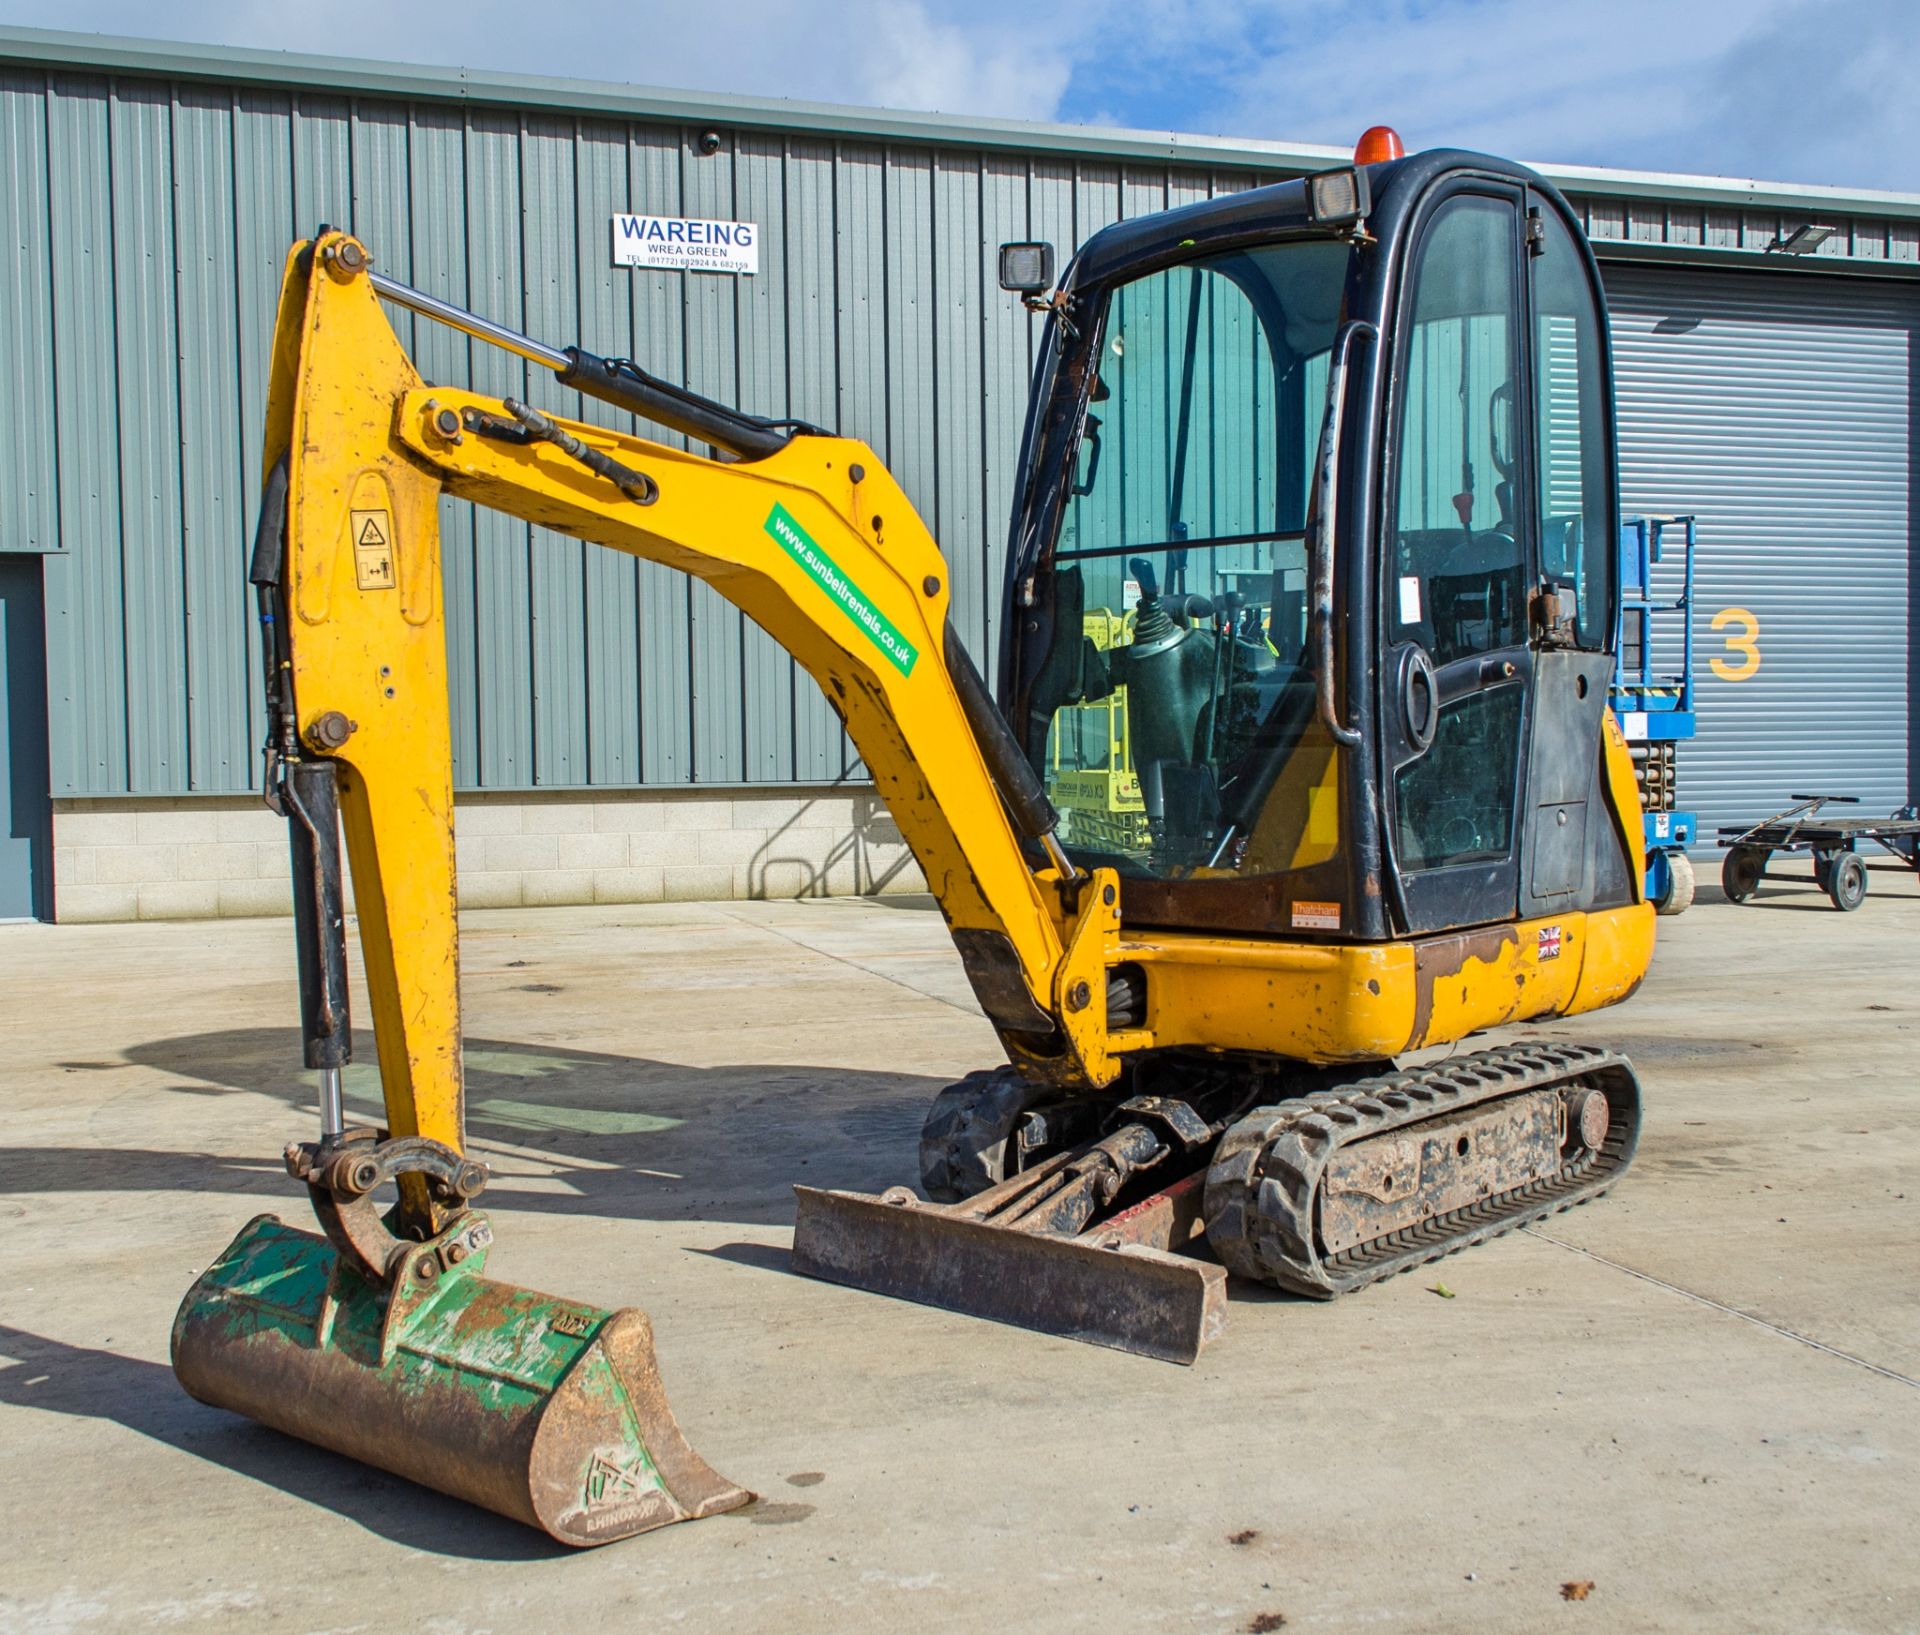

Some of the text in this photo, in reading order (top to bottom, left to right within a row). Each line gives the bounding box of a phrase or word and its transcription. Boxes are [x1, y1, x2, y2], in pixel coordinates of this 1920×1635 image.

[621, 216, 752, 246] WAREING
[648, 244, 728, 257] WREA GREEN
[648, 257, 678, 266] (01772)
[775, 517, 910, 666] www.sunbeltrentals.co.uk
[1709, 607, 1762, 682] 3
